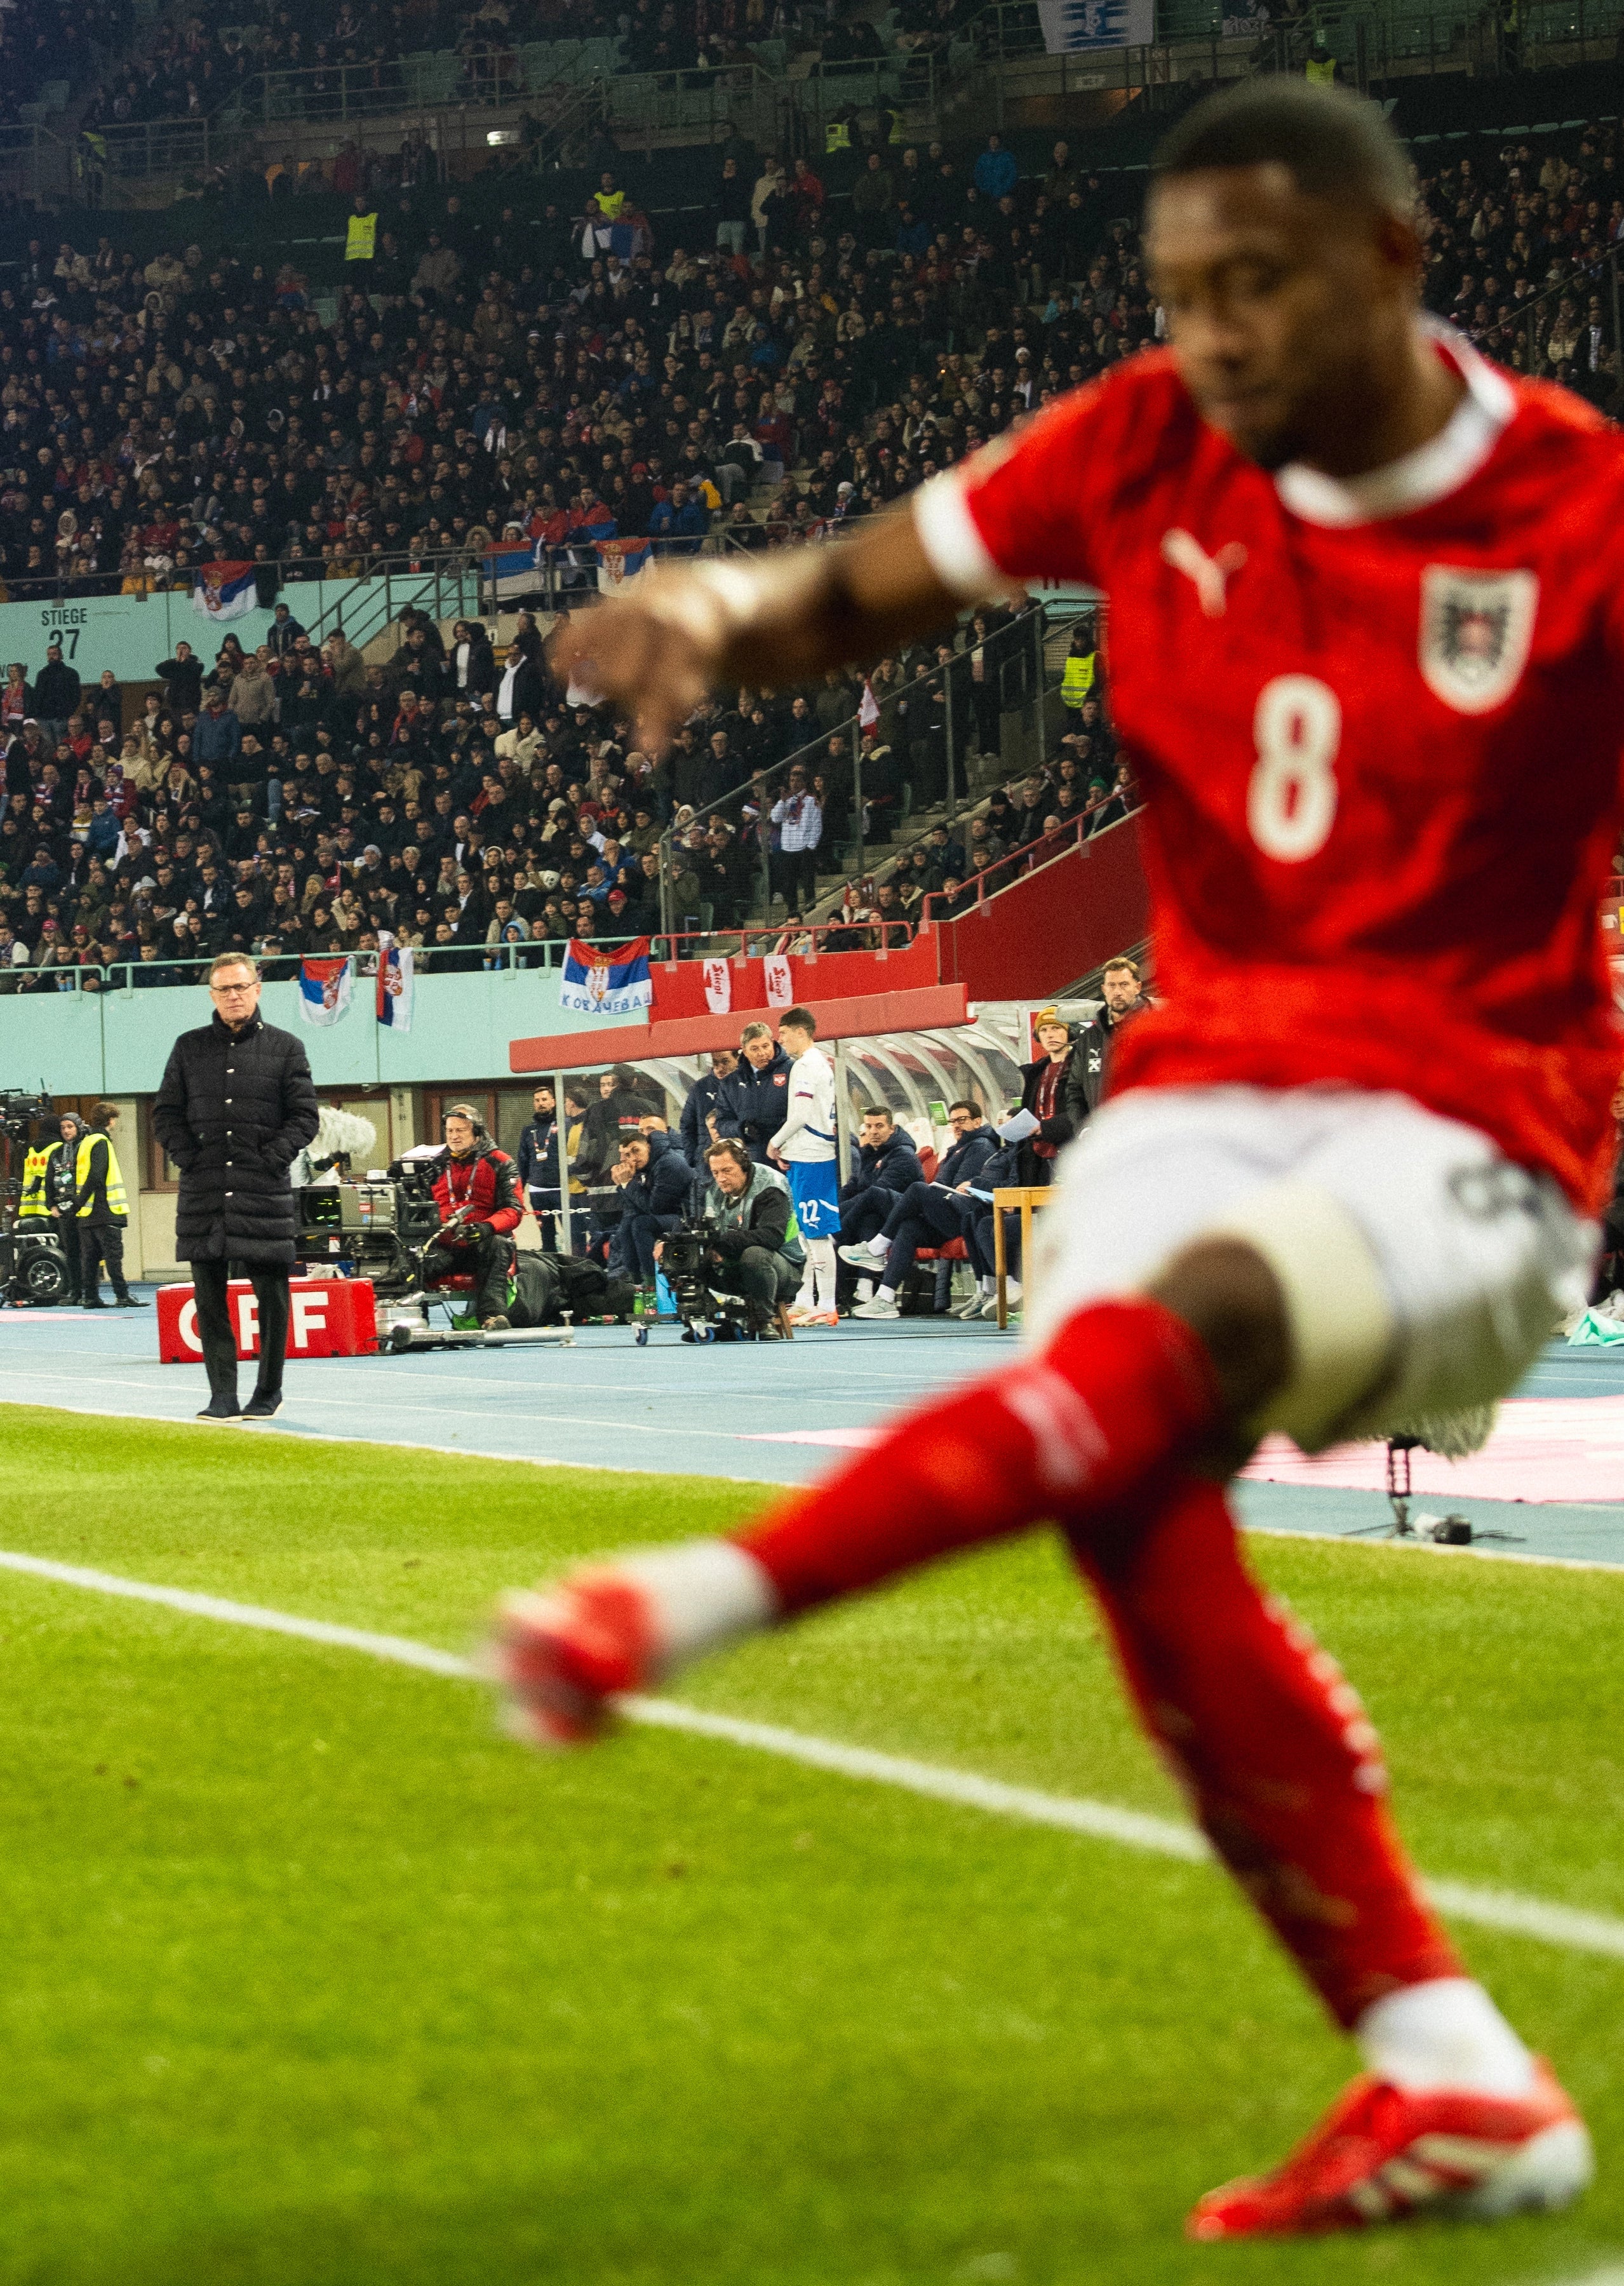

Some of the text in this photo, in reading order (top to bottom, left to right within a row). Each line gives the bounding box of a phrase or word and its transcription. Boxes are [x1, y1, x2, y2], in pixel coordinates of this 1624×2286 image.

[41, 608, 88, 626] STIEGE
[49, 628, 80, 659] 27
[1246, 673, 1342, 864] 8
[798, 1199, 821, 1223] 22
